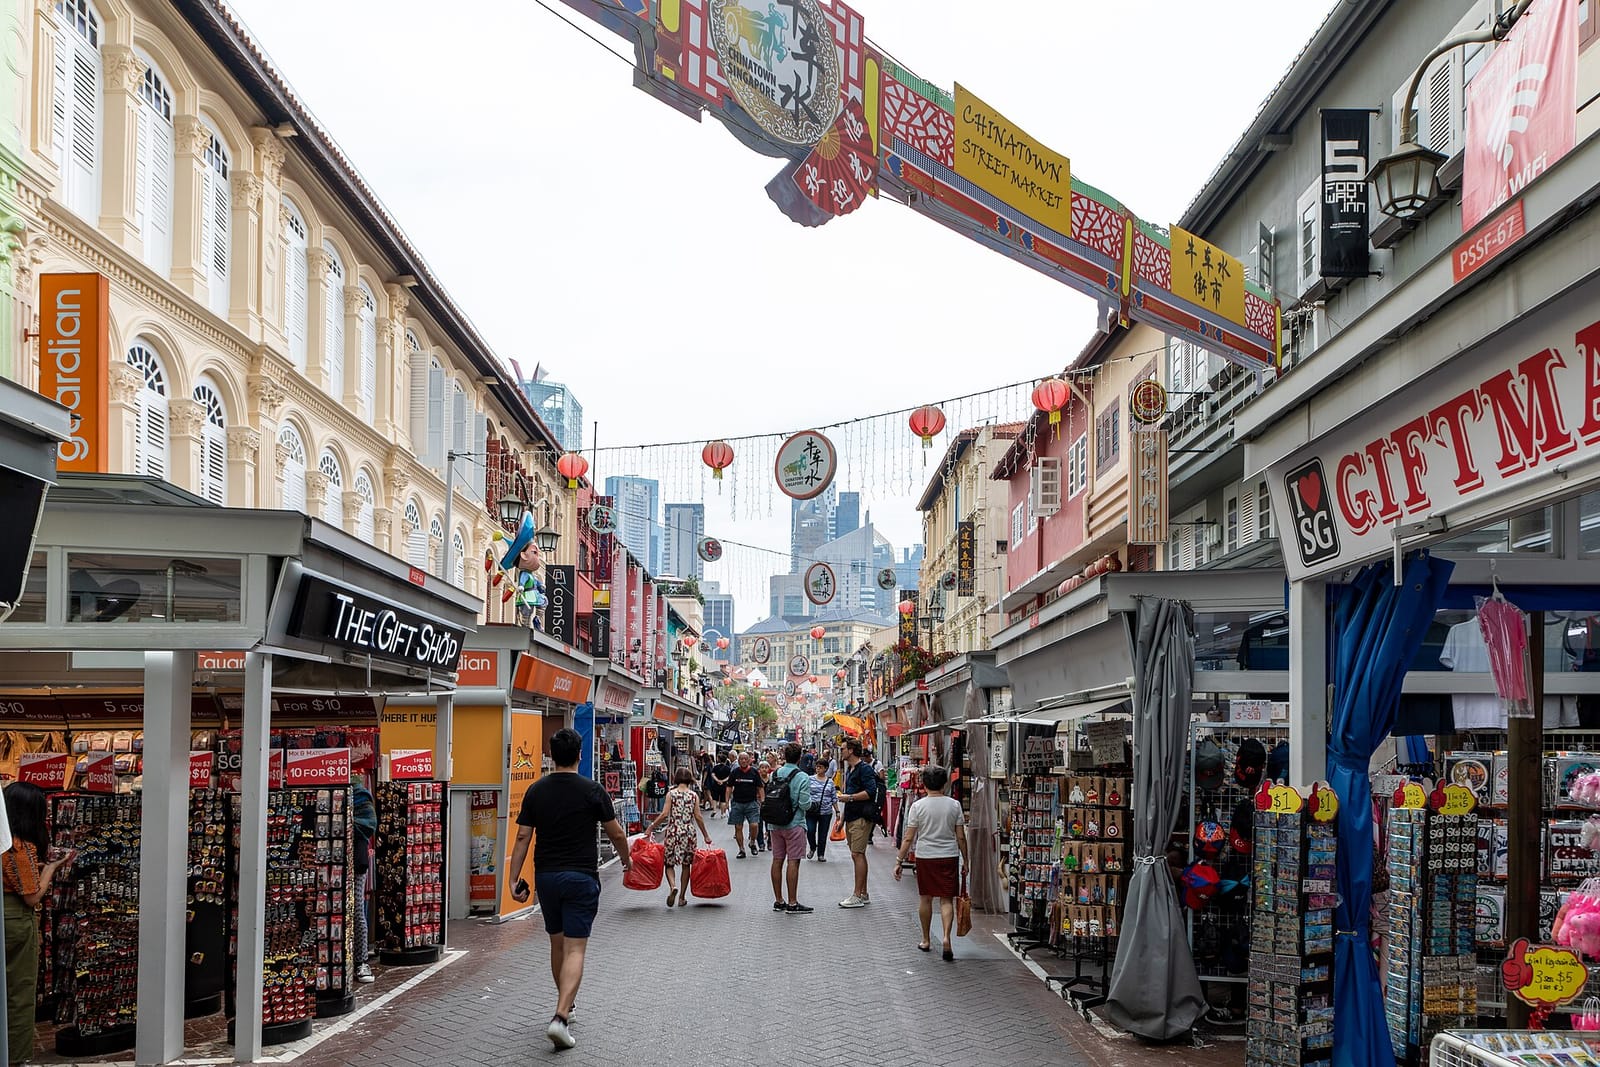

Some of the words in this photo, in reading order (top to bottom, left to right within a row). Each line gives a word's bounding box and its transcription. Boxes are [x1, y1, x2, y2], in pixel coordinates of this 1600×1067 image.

[728, 47, 776, 87] CHINATOWN
[727, 62, 776, 101] SINGAPORE
[962, 105, 1063, 183] CHINATOWN
[1325, 140, 1366, 182] 5
[962, 138, 1009, 177] STREET
[1010, 168, 1063, 210] MARKET
[1509, 150, 1547, 196] WiFi
[1325, 182, 1366, 193] FOOT
[1325, 190, 1357, 204] WAY
[1460, 215, 1515, 272] PSSF-67
[48, 289, 89, 462] gardian
[1290, 480, 1305, 518] I
[1299, 510, 1332, 556] SG
[334, 593, 375, 646] THE
[376, 610, 419, 656] GIFT
[416, 624, 458, 666] SHOP
[456, 655, 491, 671] dian
[104, 701, 117, 713] 5
[121, 704, 144, 713] FOR
[283, 702, 309, 712] FOR
[312, 699, 341, 711] $10
[410, 714, 418, 722] IT
[218, 755, 242, 770] SG
[395, 764, 402, 772] 7
[418, 764, 432, 772] $10
[25, 772, 31, 781] 7
[31, 773, 48, 781] FOR
[48, 771, 65, 781] $10
[192, 768, 210, 779] $10
[290, 768, 302, 777] 10
[327, 766, 348, 777] $10
[1274, 792, 1291, 811] $1
[472, 812, 492, 820] EALS
[1535, 970, 1543, 983] 3
[1556, 970, 1573, 985] $5
